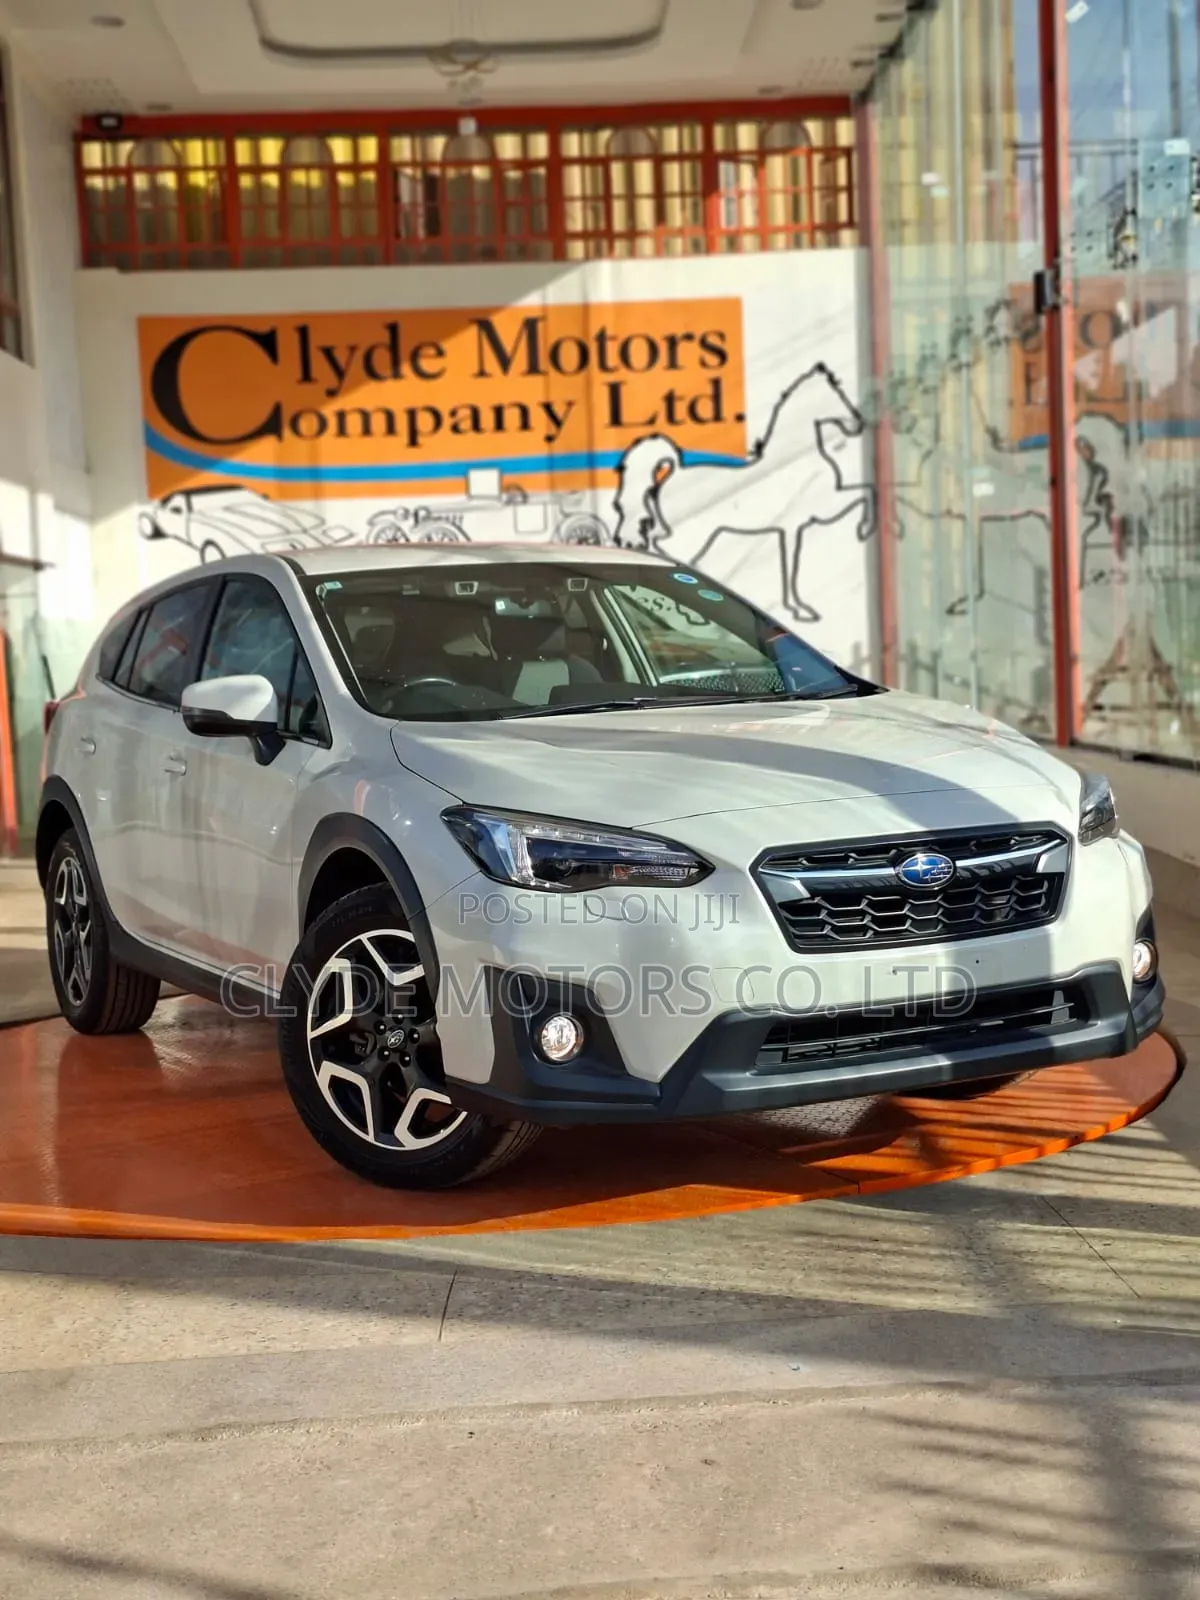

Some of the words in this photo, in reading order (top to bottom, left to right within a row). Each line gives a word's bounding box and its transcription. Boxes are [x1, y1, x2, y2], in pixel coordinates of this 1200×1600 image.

[150, 321, 447, 446] Clyde
[469, 315, 729, 379] Motors
[604, 376, 747, 429] Ltd.
